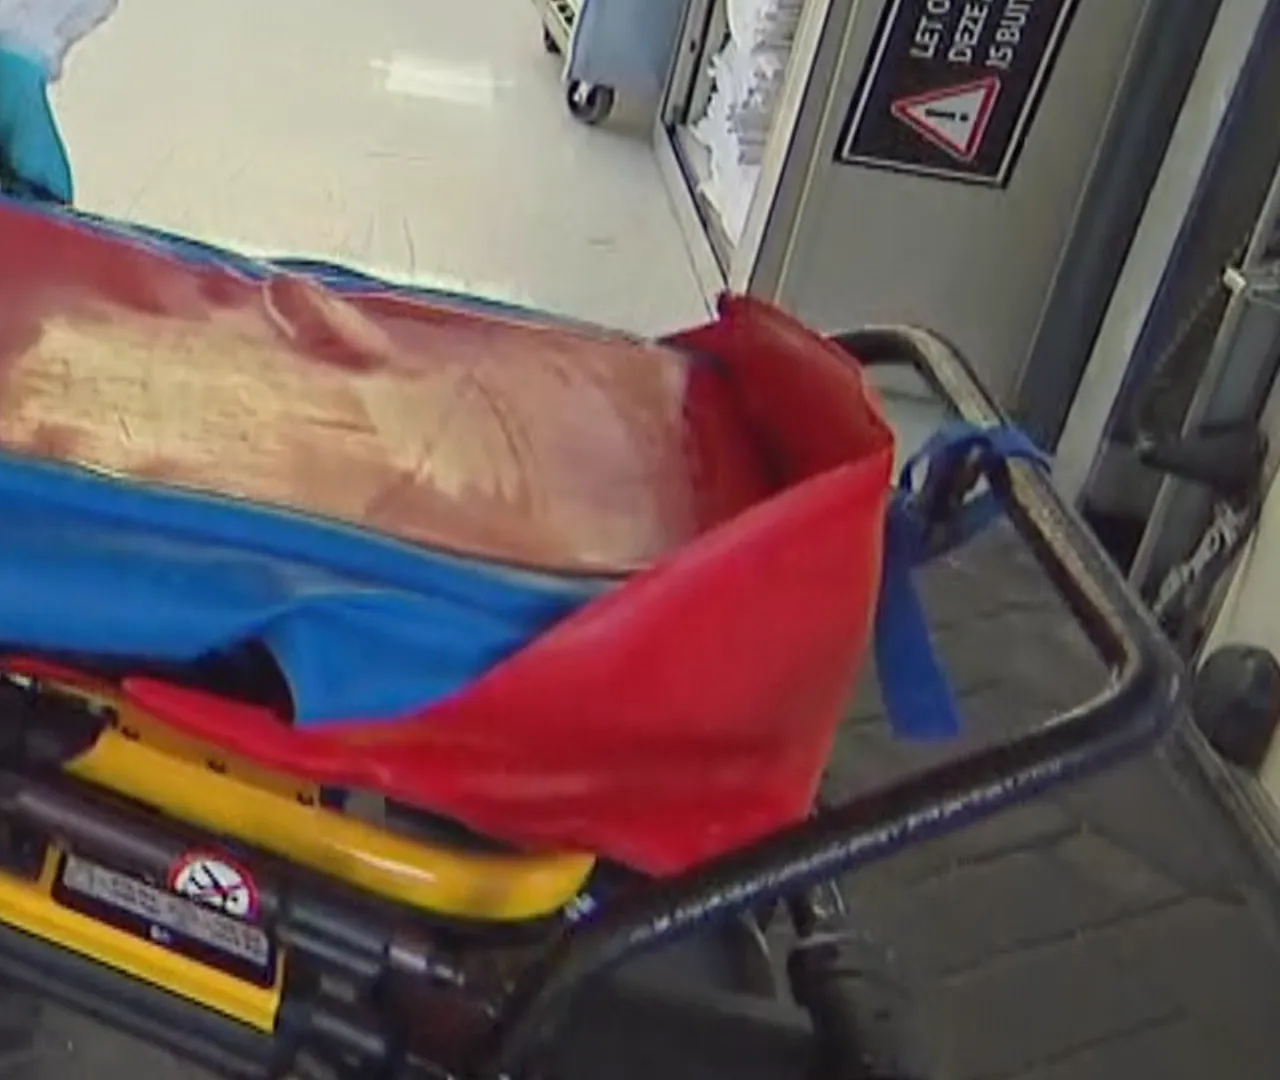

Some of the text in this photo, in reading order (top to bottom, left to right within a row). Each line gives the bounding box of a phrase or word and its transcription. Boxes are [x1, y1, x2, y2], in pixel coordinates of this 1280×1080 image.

[909, 16, 942, 60] LET
[947, 3, 989, 64] DEZE
[985, 46, 1014, 71] IS
